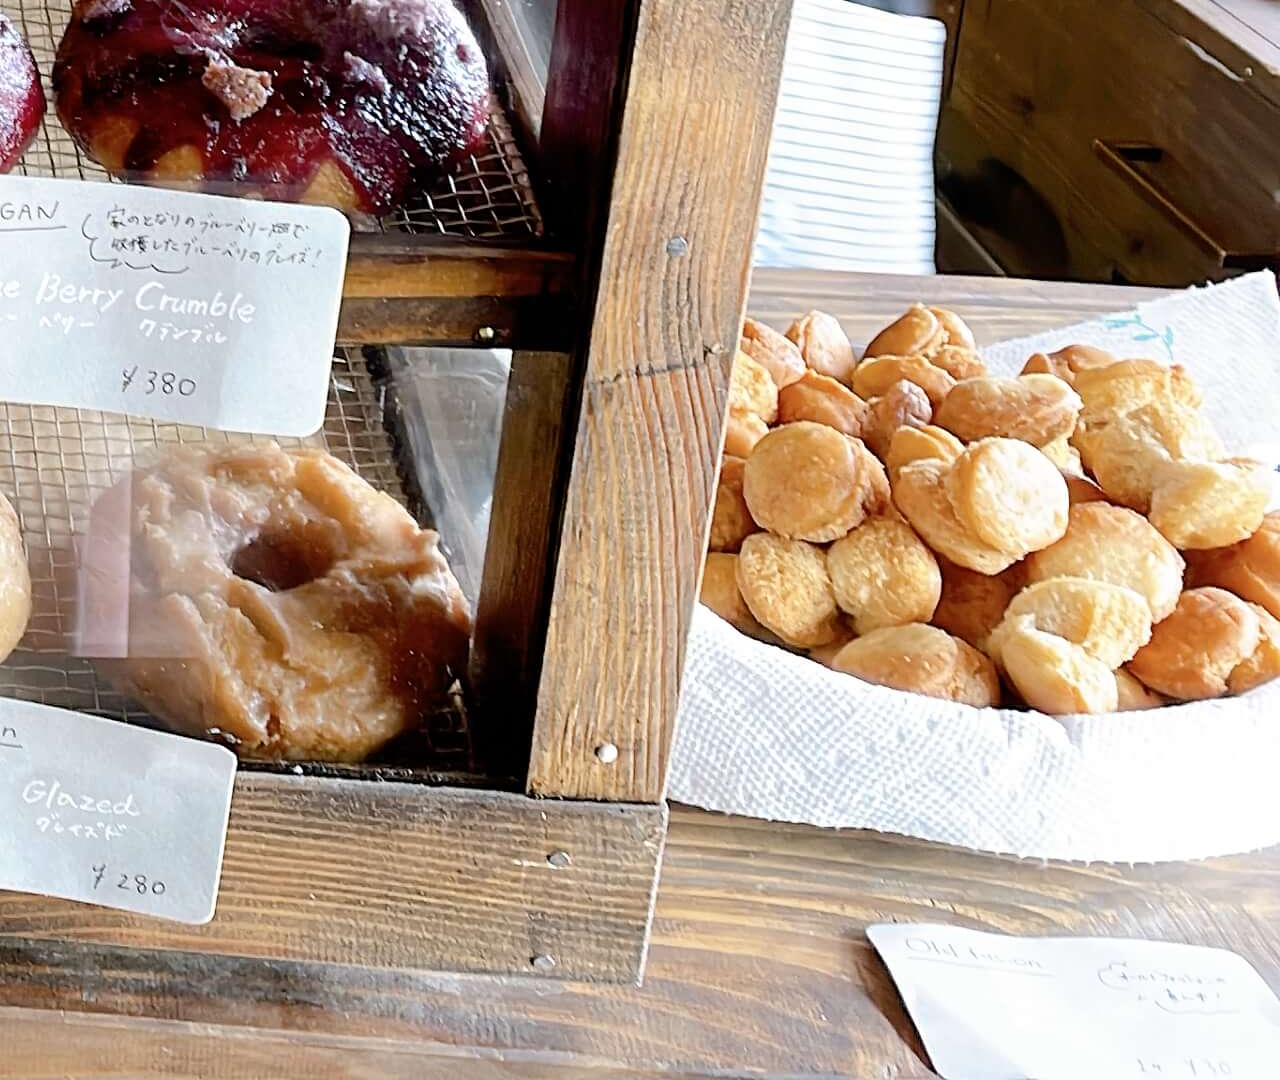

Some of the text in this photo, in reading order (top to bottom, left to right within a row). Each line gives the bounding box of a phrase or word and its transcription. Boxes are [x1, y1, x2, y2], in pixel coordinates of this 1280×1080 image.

[35, 272, 123, 308] Berry
[134, 281, 256, 323] Crumble
[121, 365, 198, 397] ¥380
[21, 778, 142, 816] Glazed
